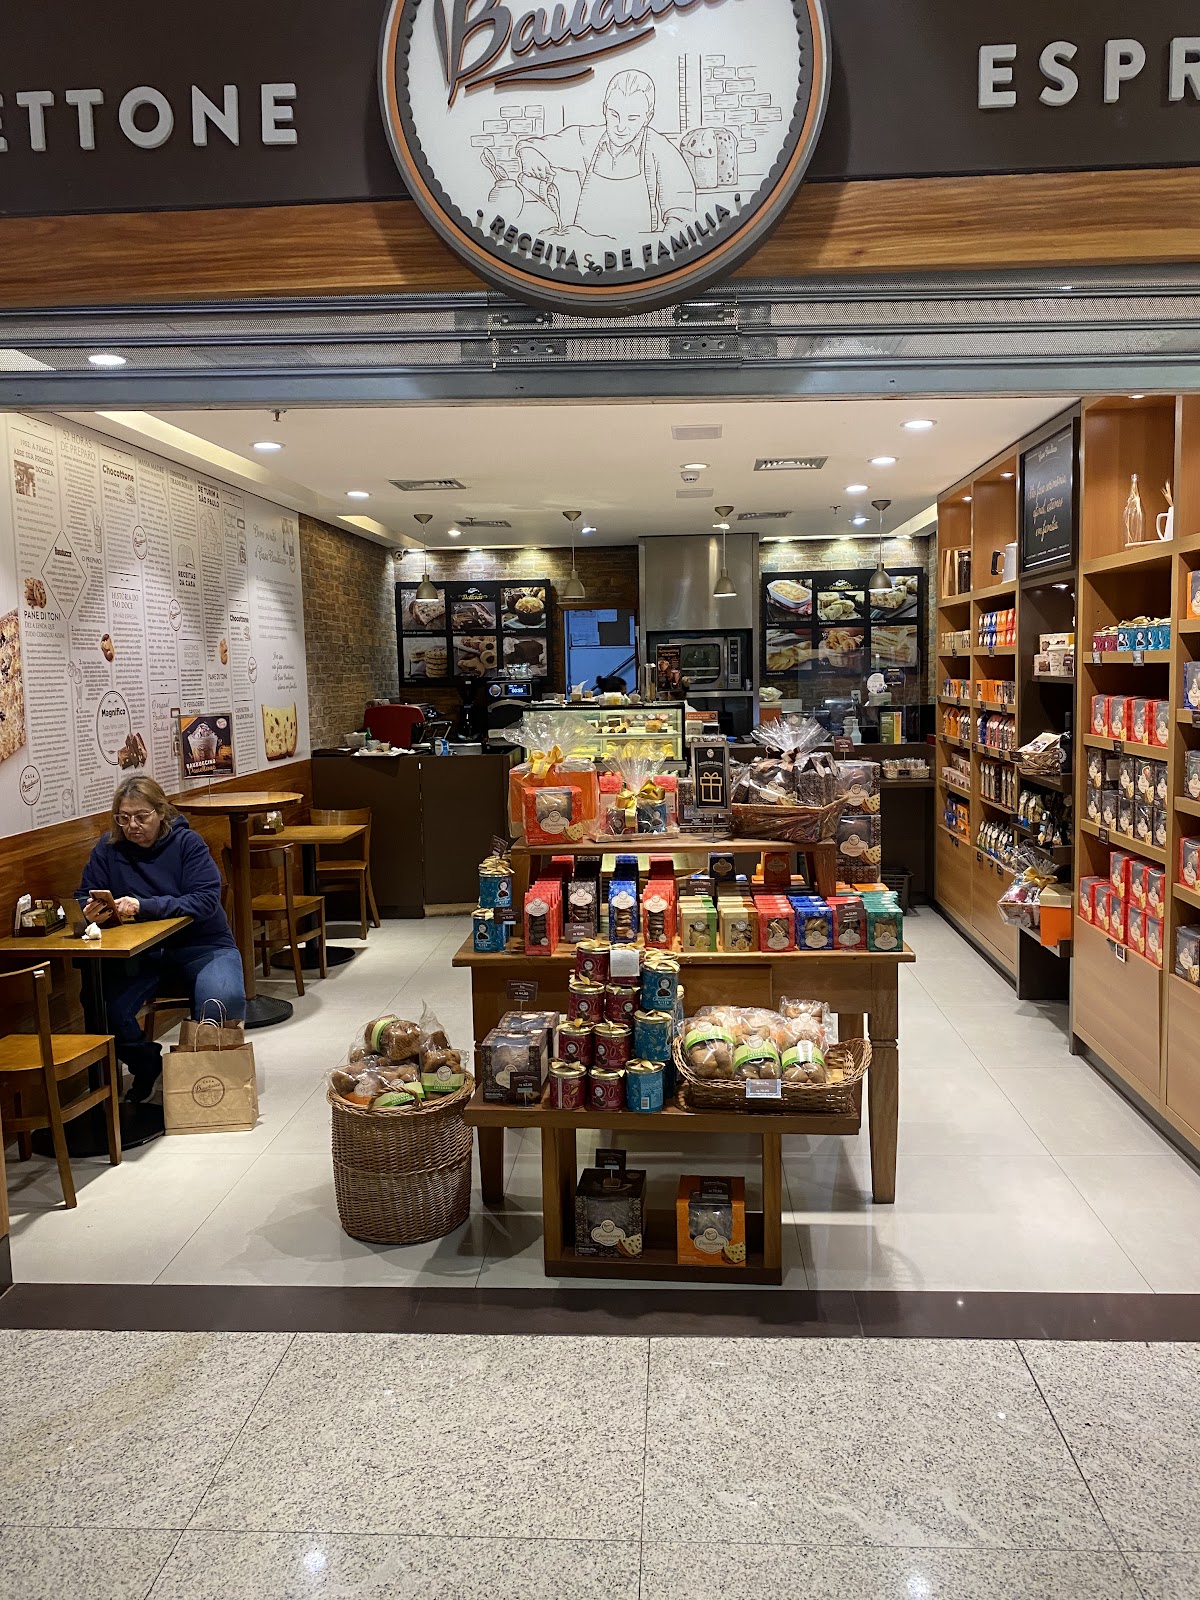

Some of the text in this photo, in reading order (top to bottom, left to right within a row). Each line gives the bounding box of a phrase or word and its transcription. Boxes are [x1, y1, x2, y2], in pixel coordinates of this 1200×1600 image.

[0, 82, 298, 152] TTONE
[604, 248, 633, 269] DE
[642, 203, 731, 267] FAMÍLIA
[72, 433, 93, 449] HORAS
[60, 441, 96, 462] DE PREPARO
[102, 464, 135, 483] Chocottone
[206, 497, 220, 509] PAULO
[24, 610, 61, 621] PANE DI TONI
